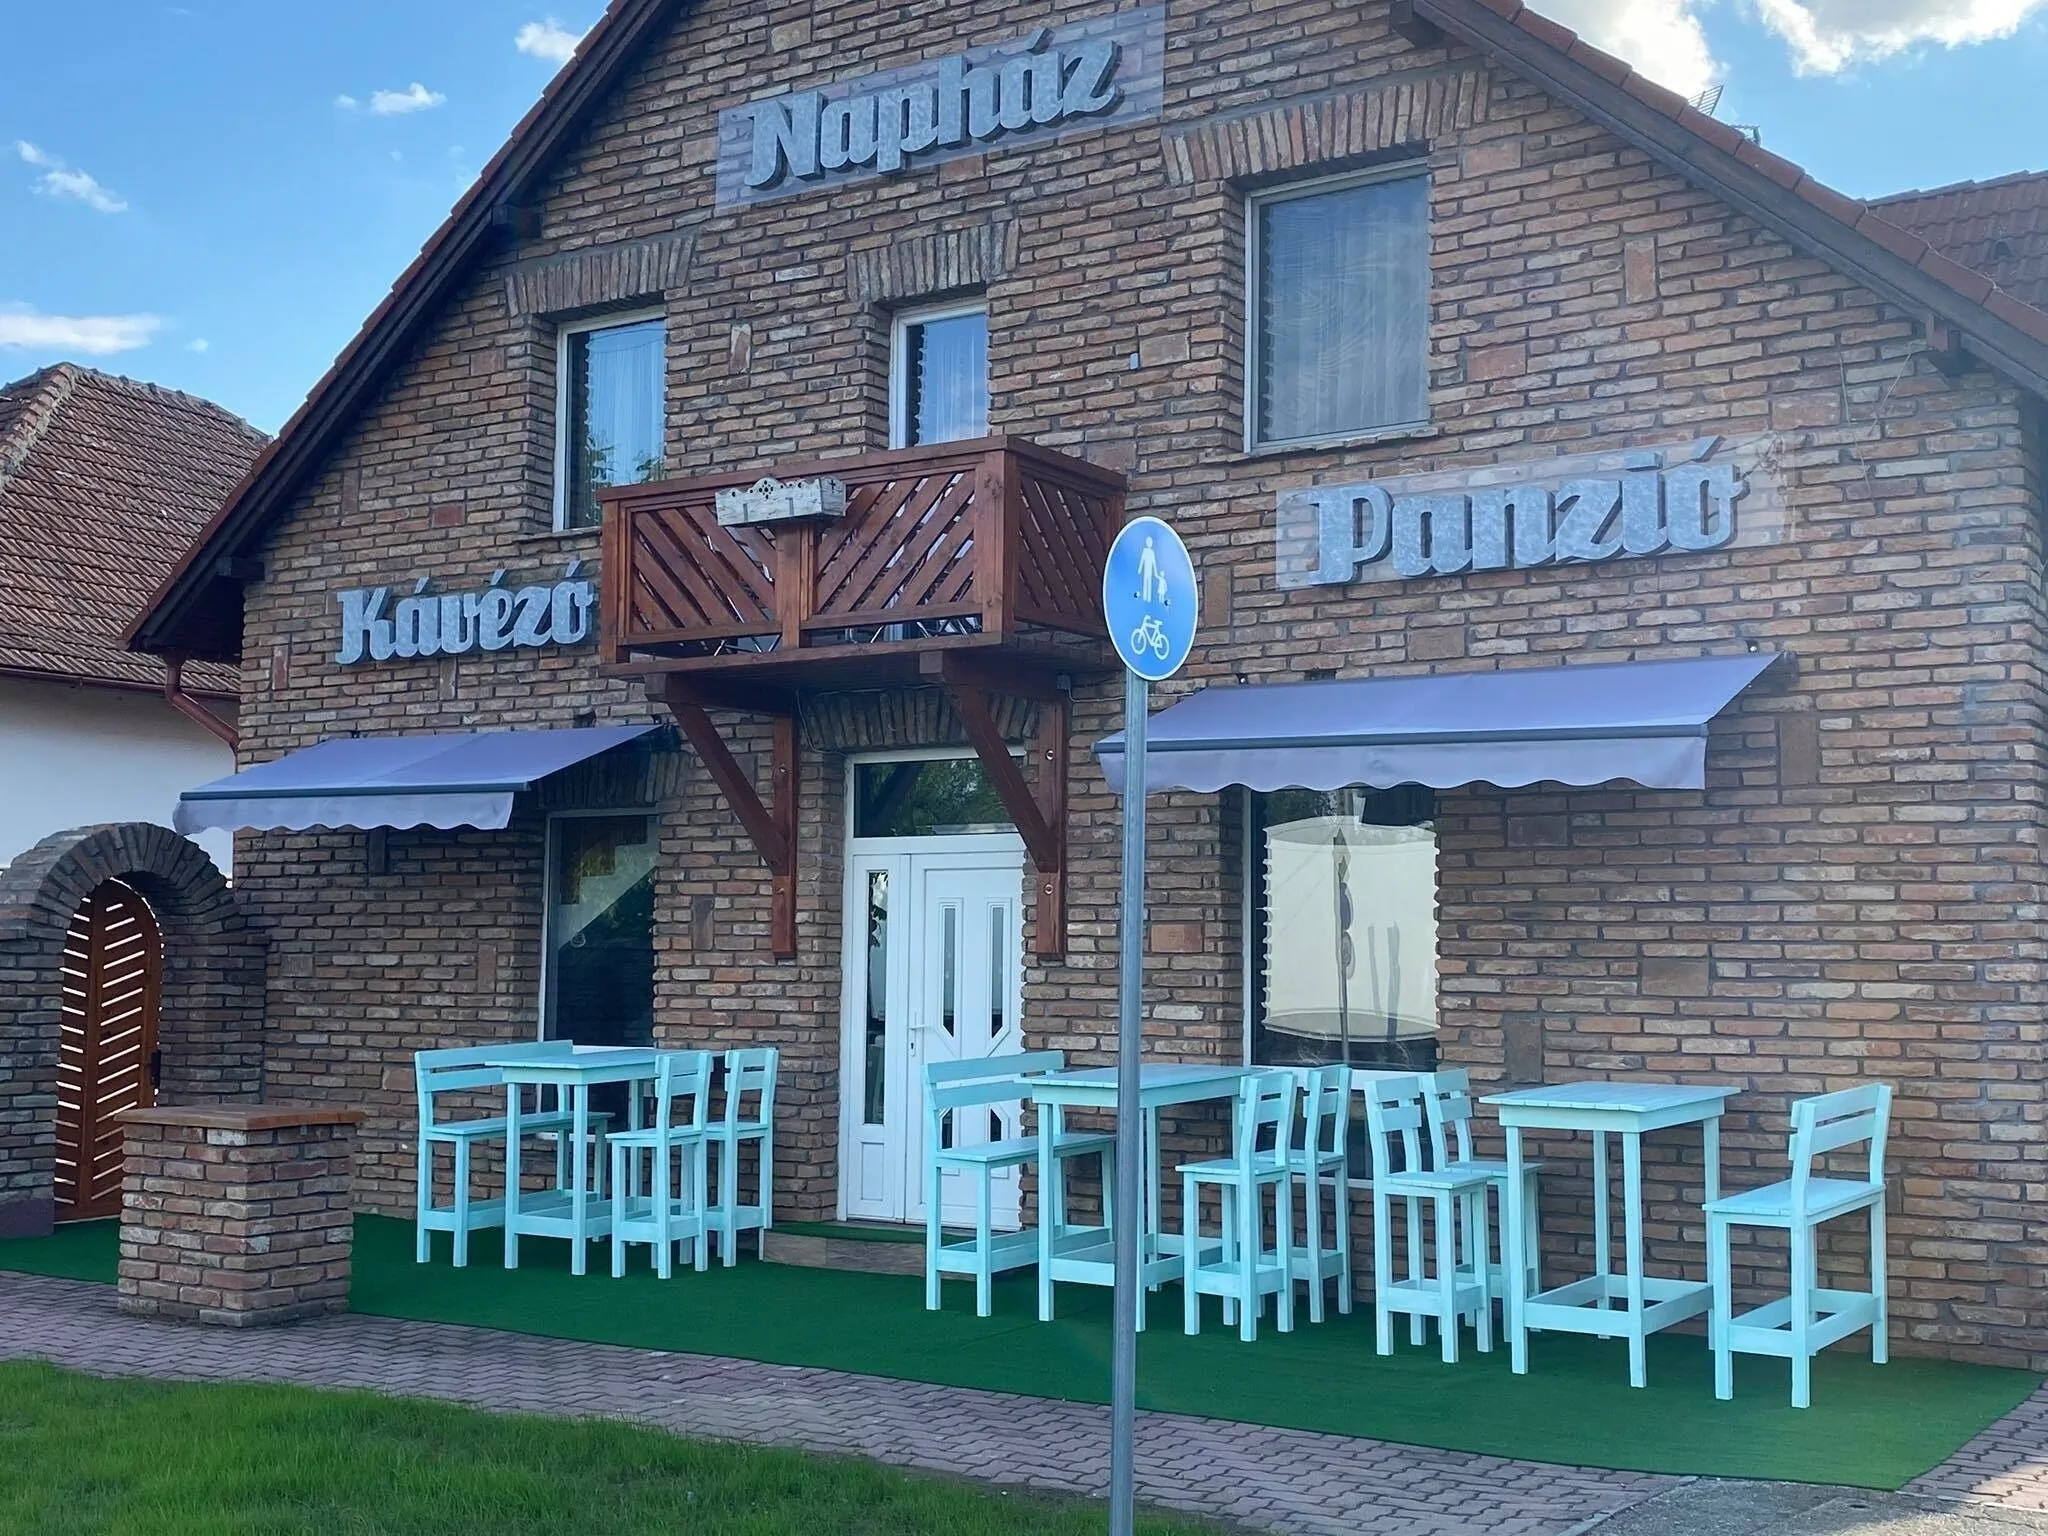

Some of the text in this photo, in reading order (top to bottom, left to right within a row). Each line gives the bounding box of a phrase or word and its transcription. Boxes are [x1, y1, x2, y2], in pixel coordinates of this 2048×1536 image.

[744, 27, 1123, 187] Napház
[1307, 435, 1748, 584] Panzió
[335, 560, 595, 665] Kávézó
